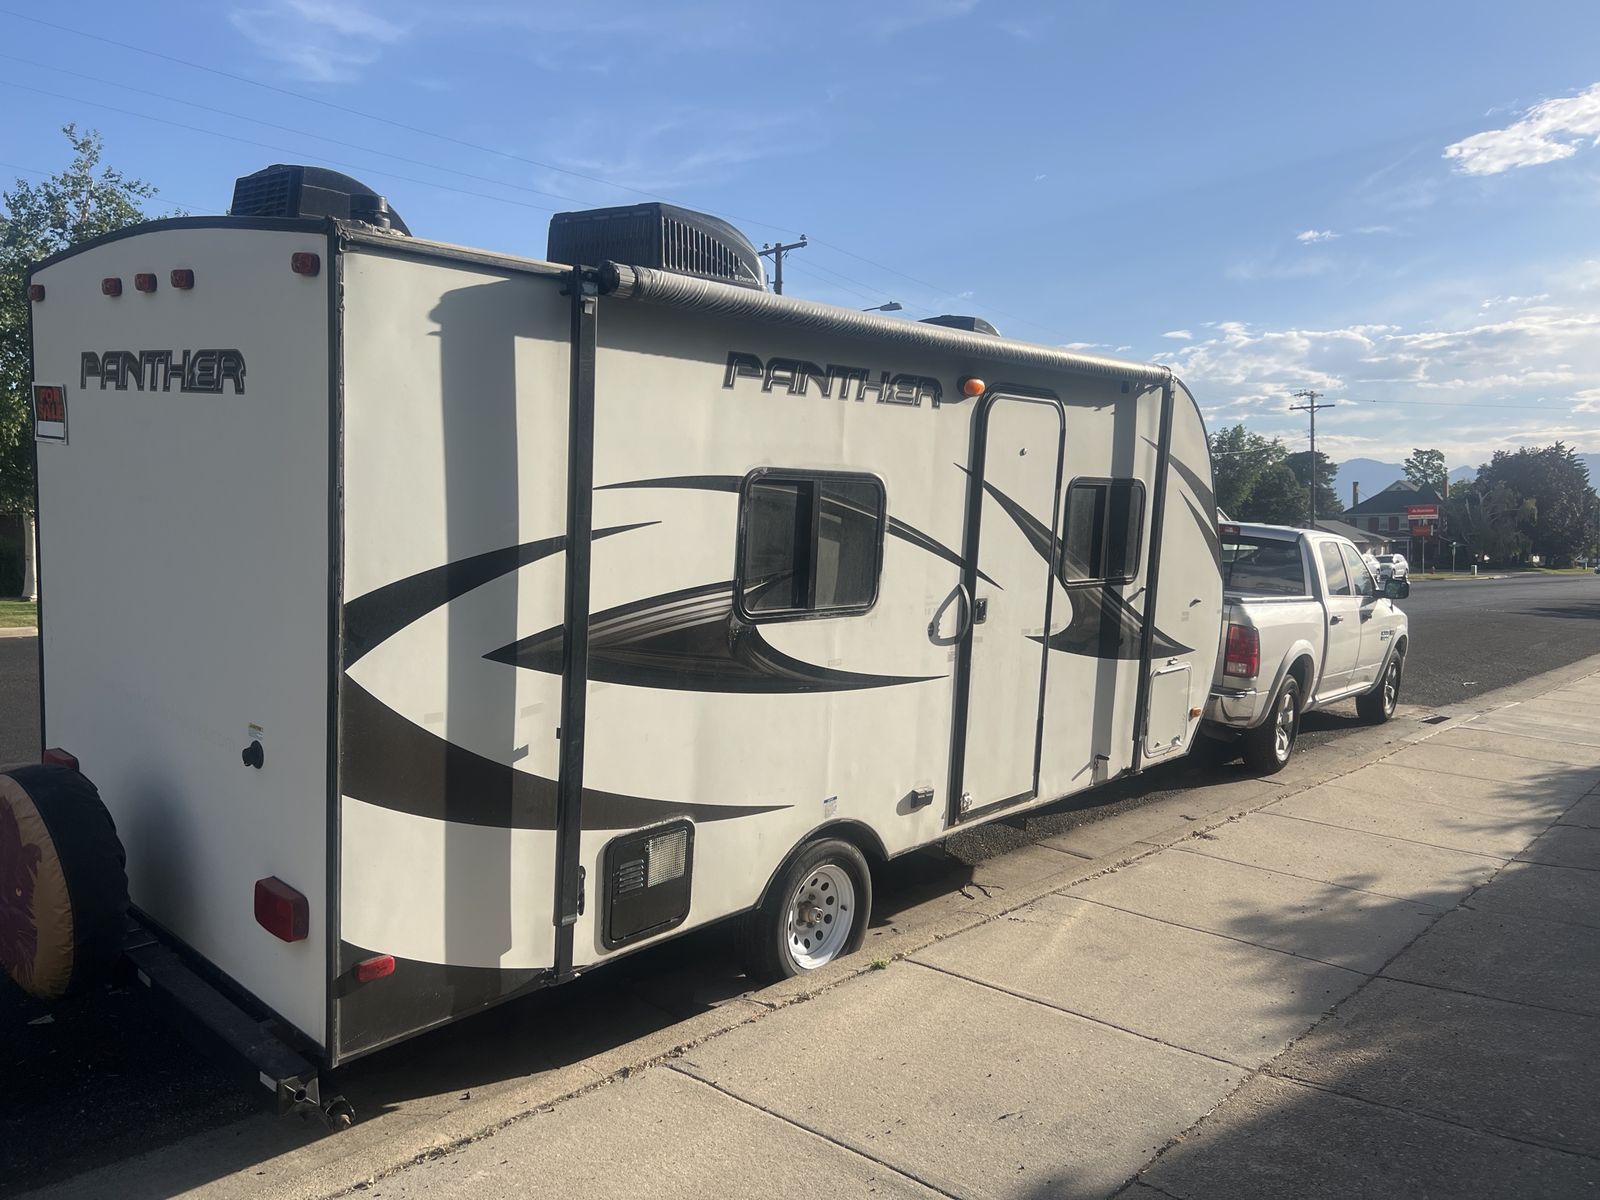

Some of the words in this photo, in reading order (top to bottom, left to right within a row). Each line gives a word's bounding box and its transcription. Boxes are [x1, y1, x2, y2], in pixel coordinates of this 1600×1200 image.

[81, 349, 246, 394] PANTHER
[722, 351, 943, 409] PANTHER
[39, 389, 60, 401] FOR
[38, 404, 64, 419] SALE
